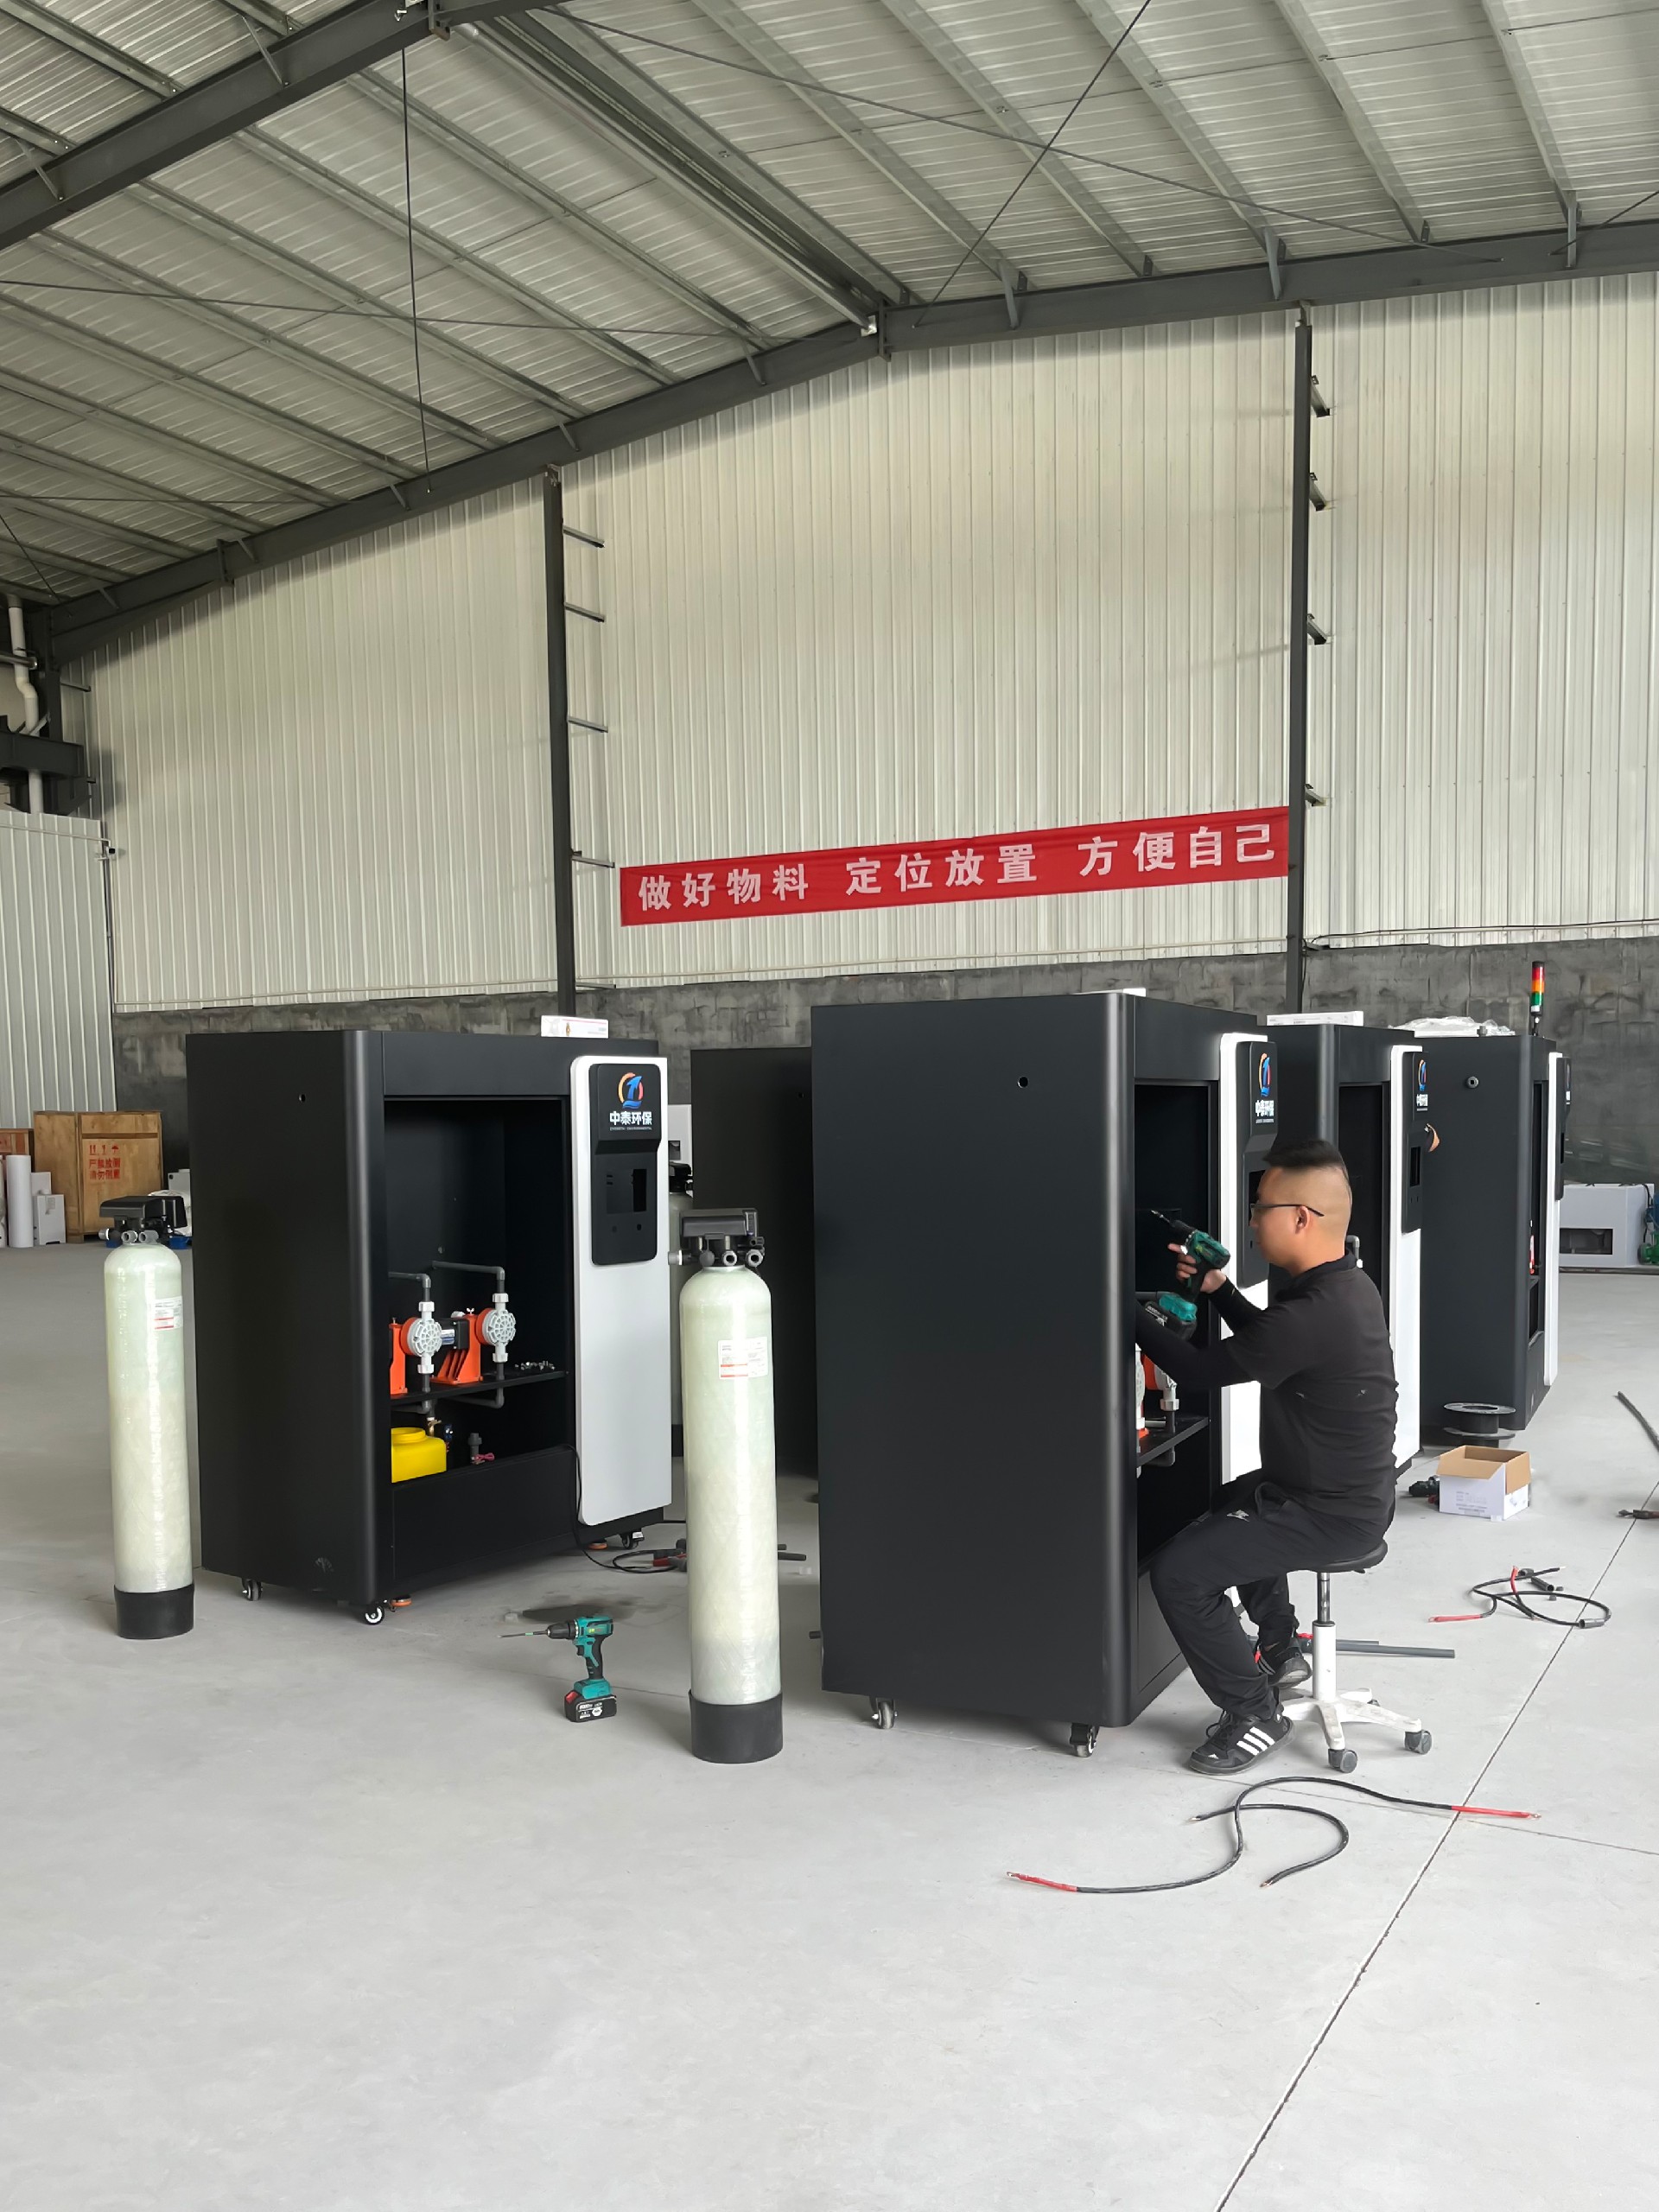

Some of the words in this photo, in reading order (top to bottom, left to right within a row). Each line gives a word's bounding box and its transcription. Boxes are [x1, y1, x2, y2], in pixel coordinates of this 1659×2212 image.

[639, 863, 809, 912] 做好物料
[846, 843, 1037, 896] 定位放置
[1077, 823, 1275, 877] 方便自己
[609, 1110, 652, 1126] 中泰环保
